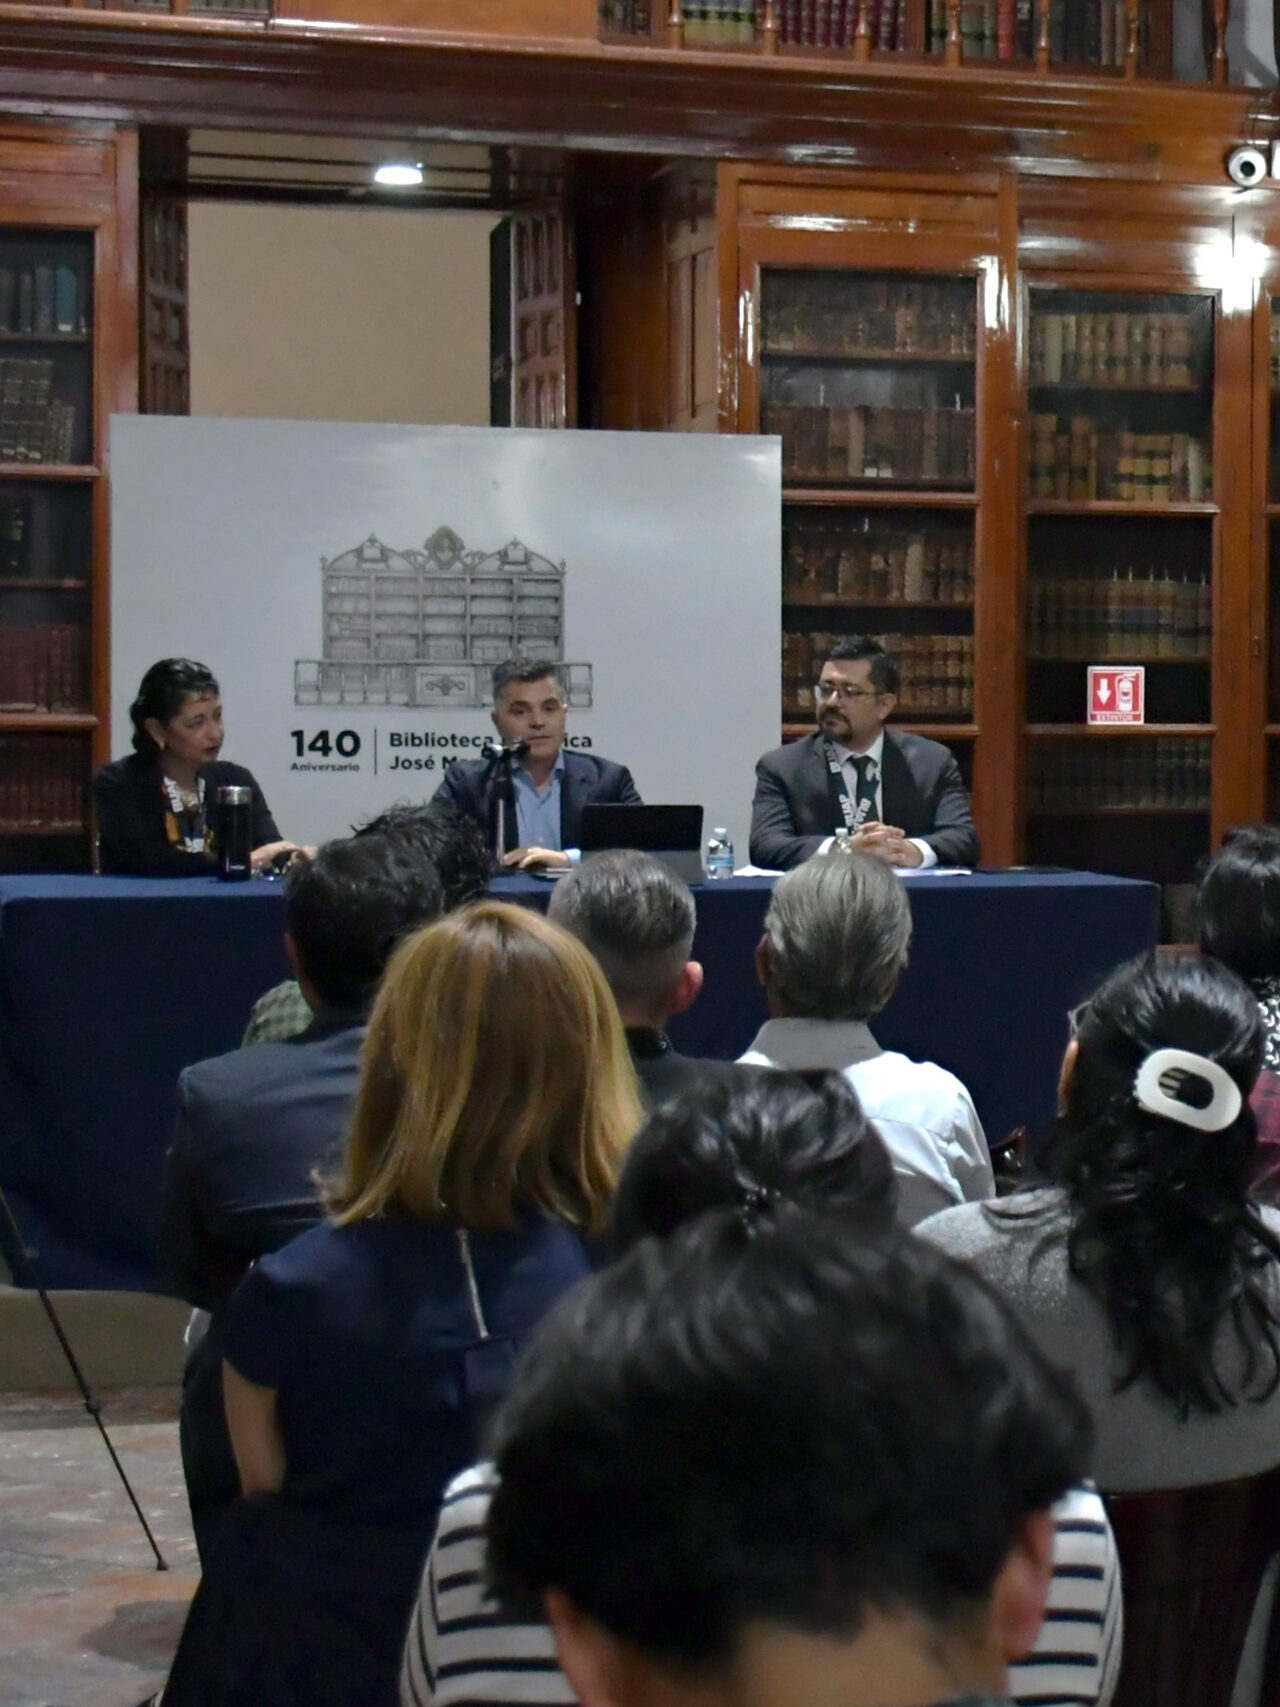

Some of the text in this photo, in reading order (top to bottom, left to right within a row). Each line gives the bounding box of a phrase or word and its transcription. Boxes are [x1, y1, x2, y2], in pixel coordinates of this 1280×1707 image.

[290, 729, 362, 758] 140
[389, 732, 494, 748] Biblioteca
[290, 762, 361, 772] Aniversario
[389, 754, 436, 771] José
